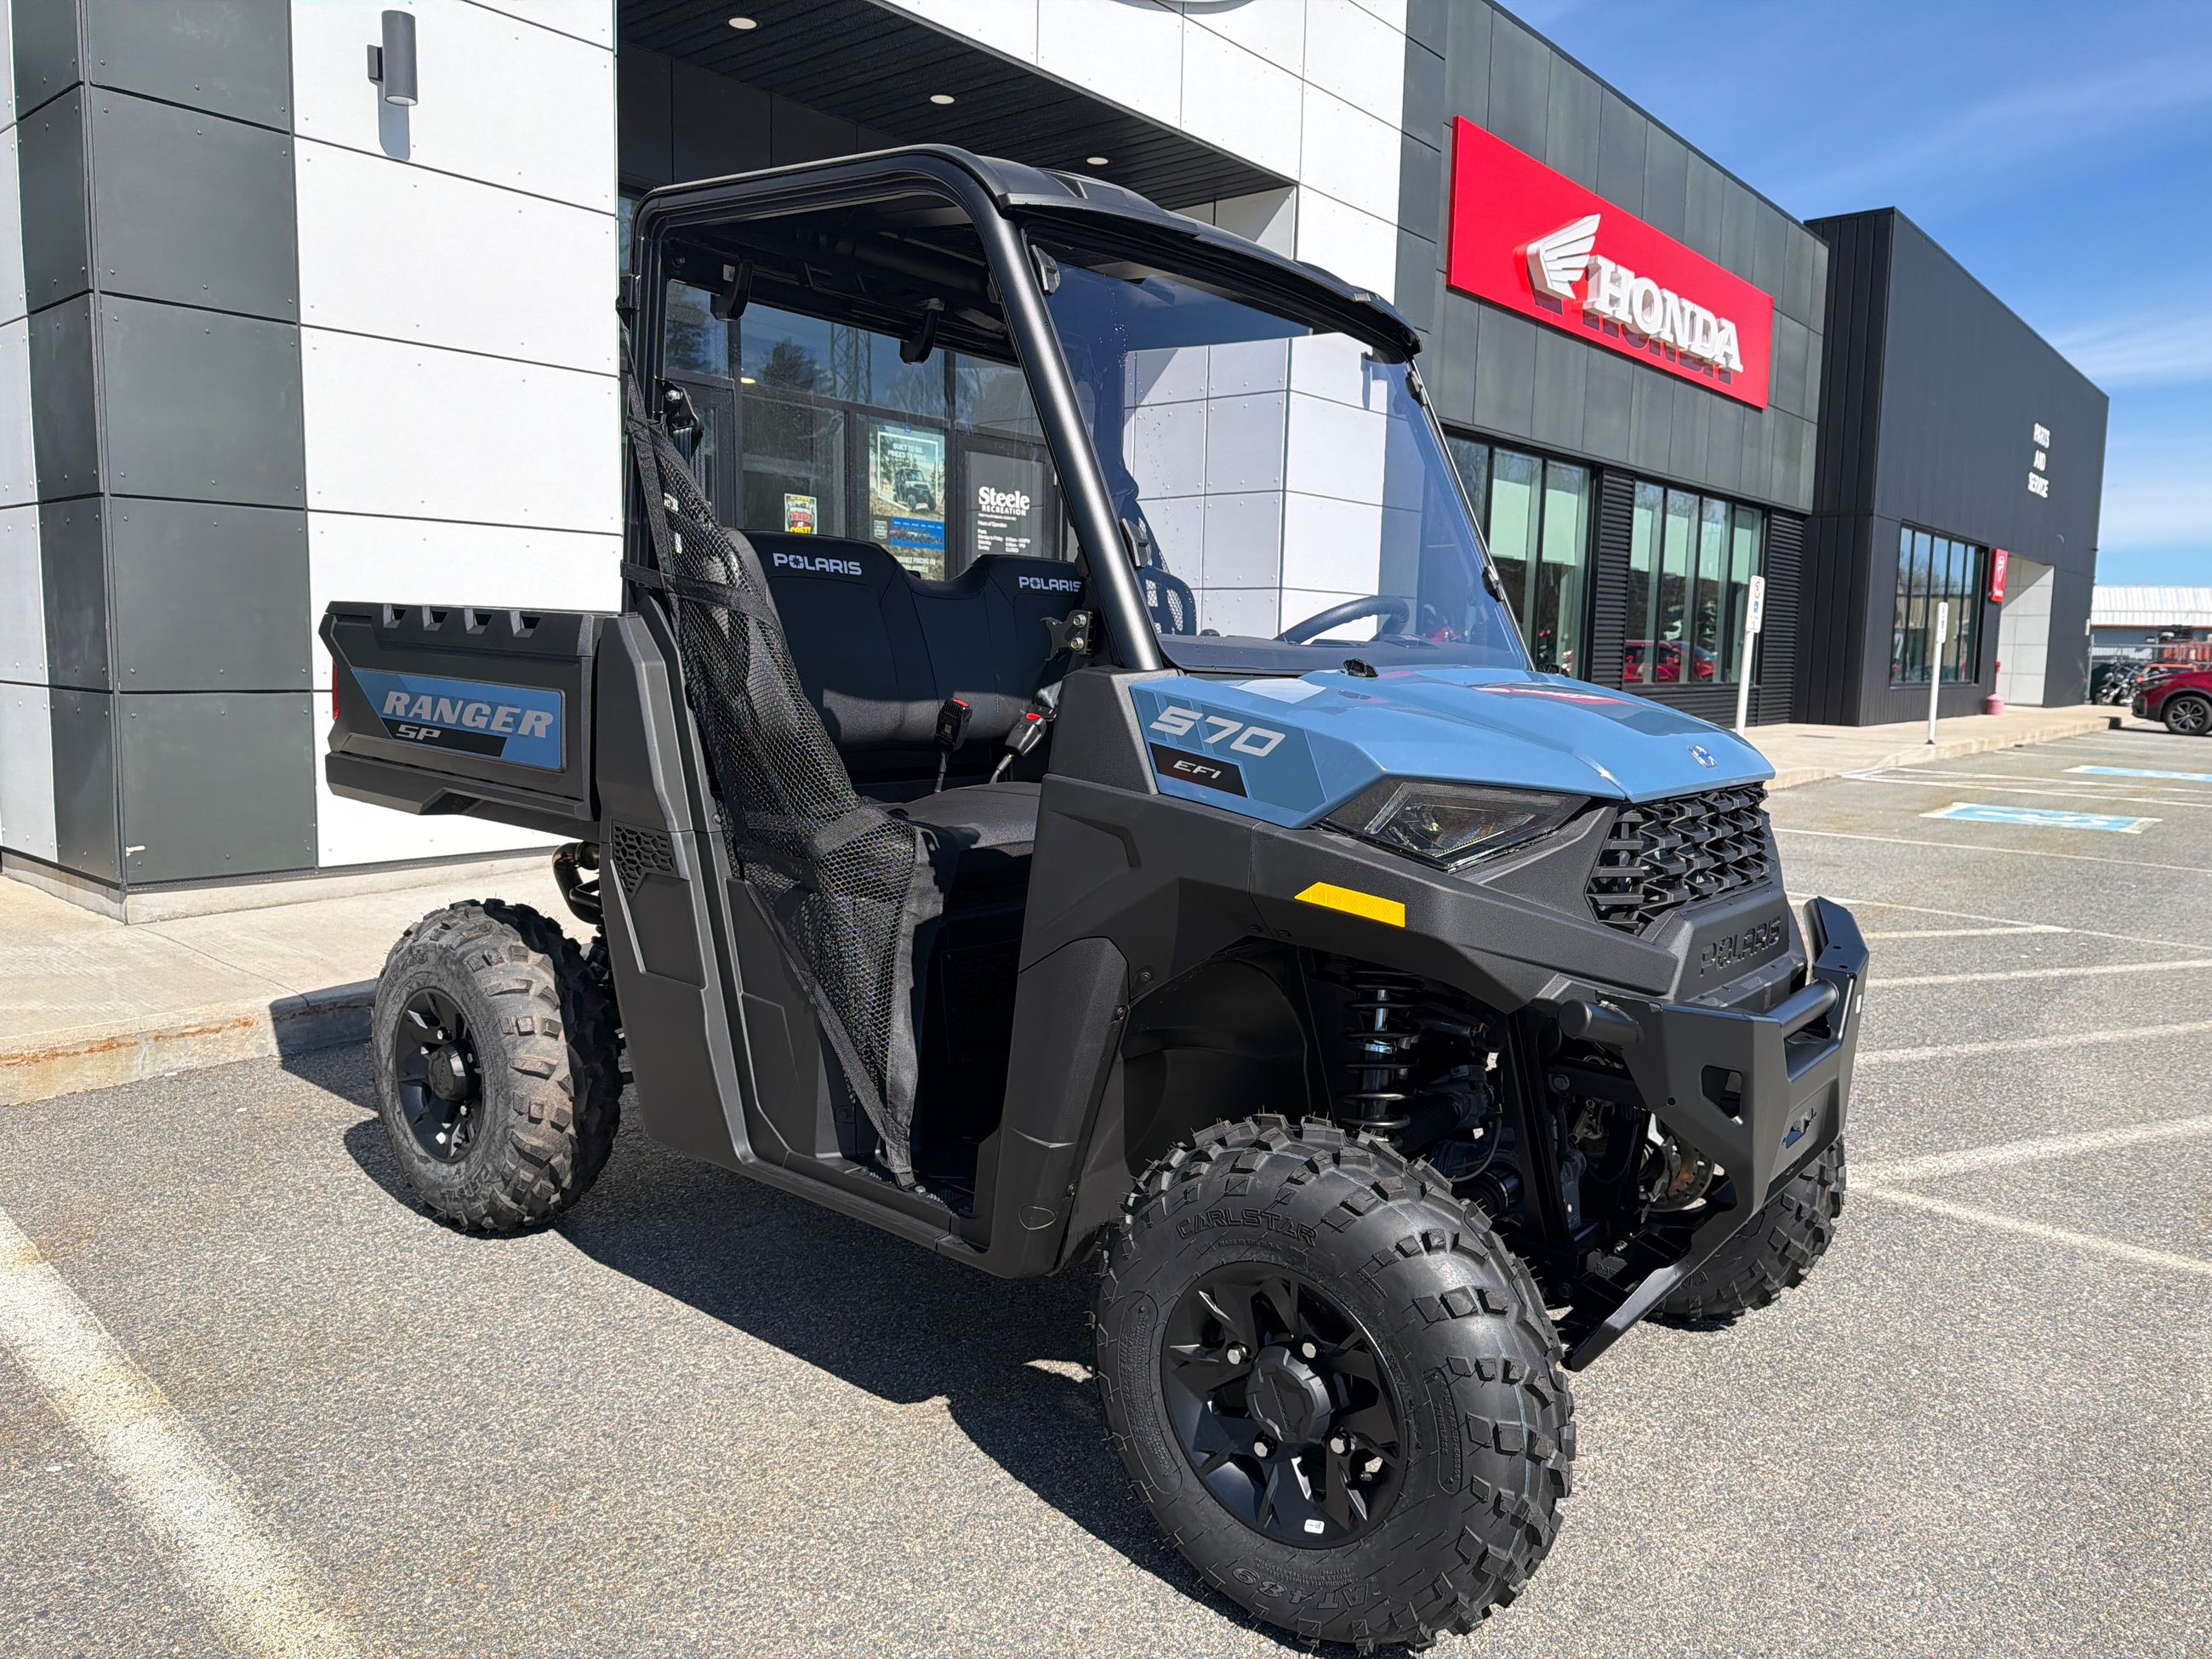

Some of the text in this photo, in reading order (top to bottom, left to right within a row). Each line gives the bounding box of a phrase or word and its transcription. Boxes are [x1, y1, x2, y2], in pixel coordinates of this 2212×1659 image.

[1585, 254, 1743, 373] HONDA
[978, 486, 1030, 510] Steele
[982, 505, 1026, 516] RECREATION
[772, 552, 862, 576] POLARIS
[1018, 576, 1082, 593] POLARIS
[383, 691, 553, 738] RANGER
[396, 724, 442, 741] SP
[1172, 760, 1222, 778] EFI
[1700, 915, 1782, 977] POLARIS
[1176, 1207, 1319, 1248] CARLSTAR
